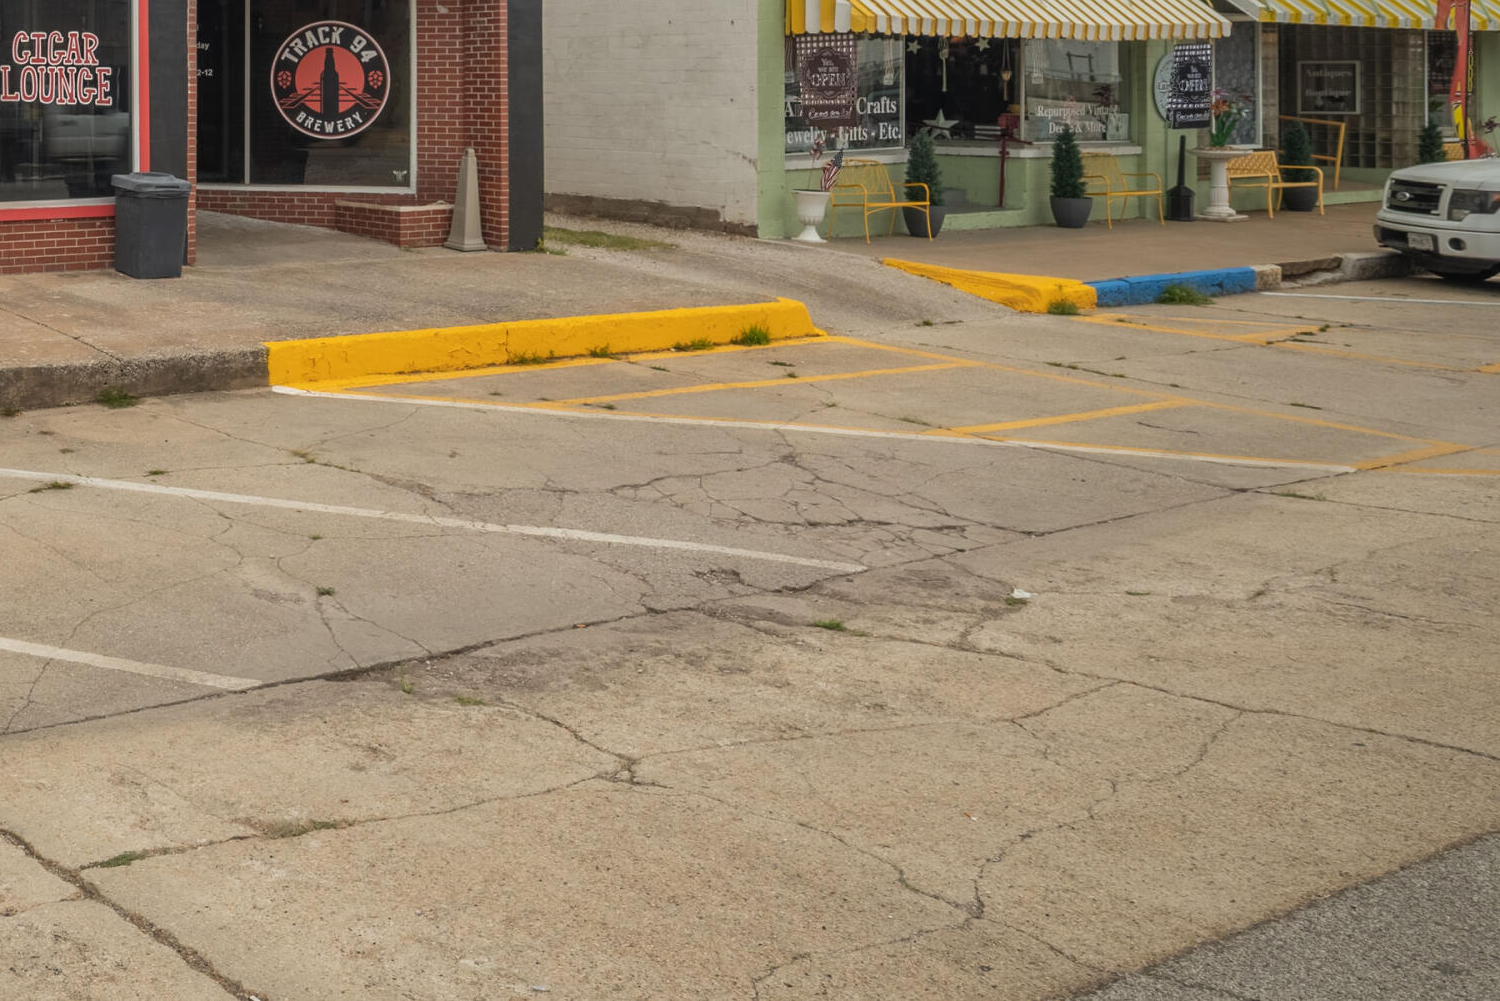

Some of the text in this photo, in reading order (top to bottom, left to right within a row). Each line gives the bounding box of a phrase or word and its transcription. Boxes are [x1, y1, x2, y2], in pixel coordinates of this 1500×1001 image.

[12, 30, 99, 66] CIGAR
[280, 25, 380, 64] TRACK 94
[0, 65, 113, 106] LOUNGE
[811, 73, 847, 87] OPEN
[856, 96, 897, 114] Crafts
[1036, 104, 1086, 120] Repurposed
[295, 110, 364, 134] BREWERY
[878, 121, 902, 140] Etc.
[1049, 121, 1073, 134] Decr
